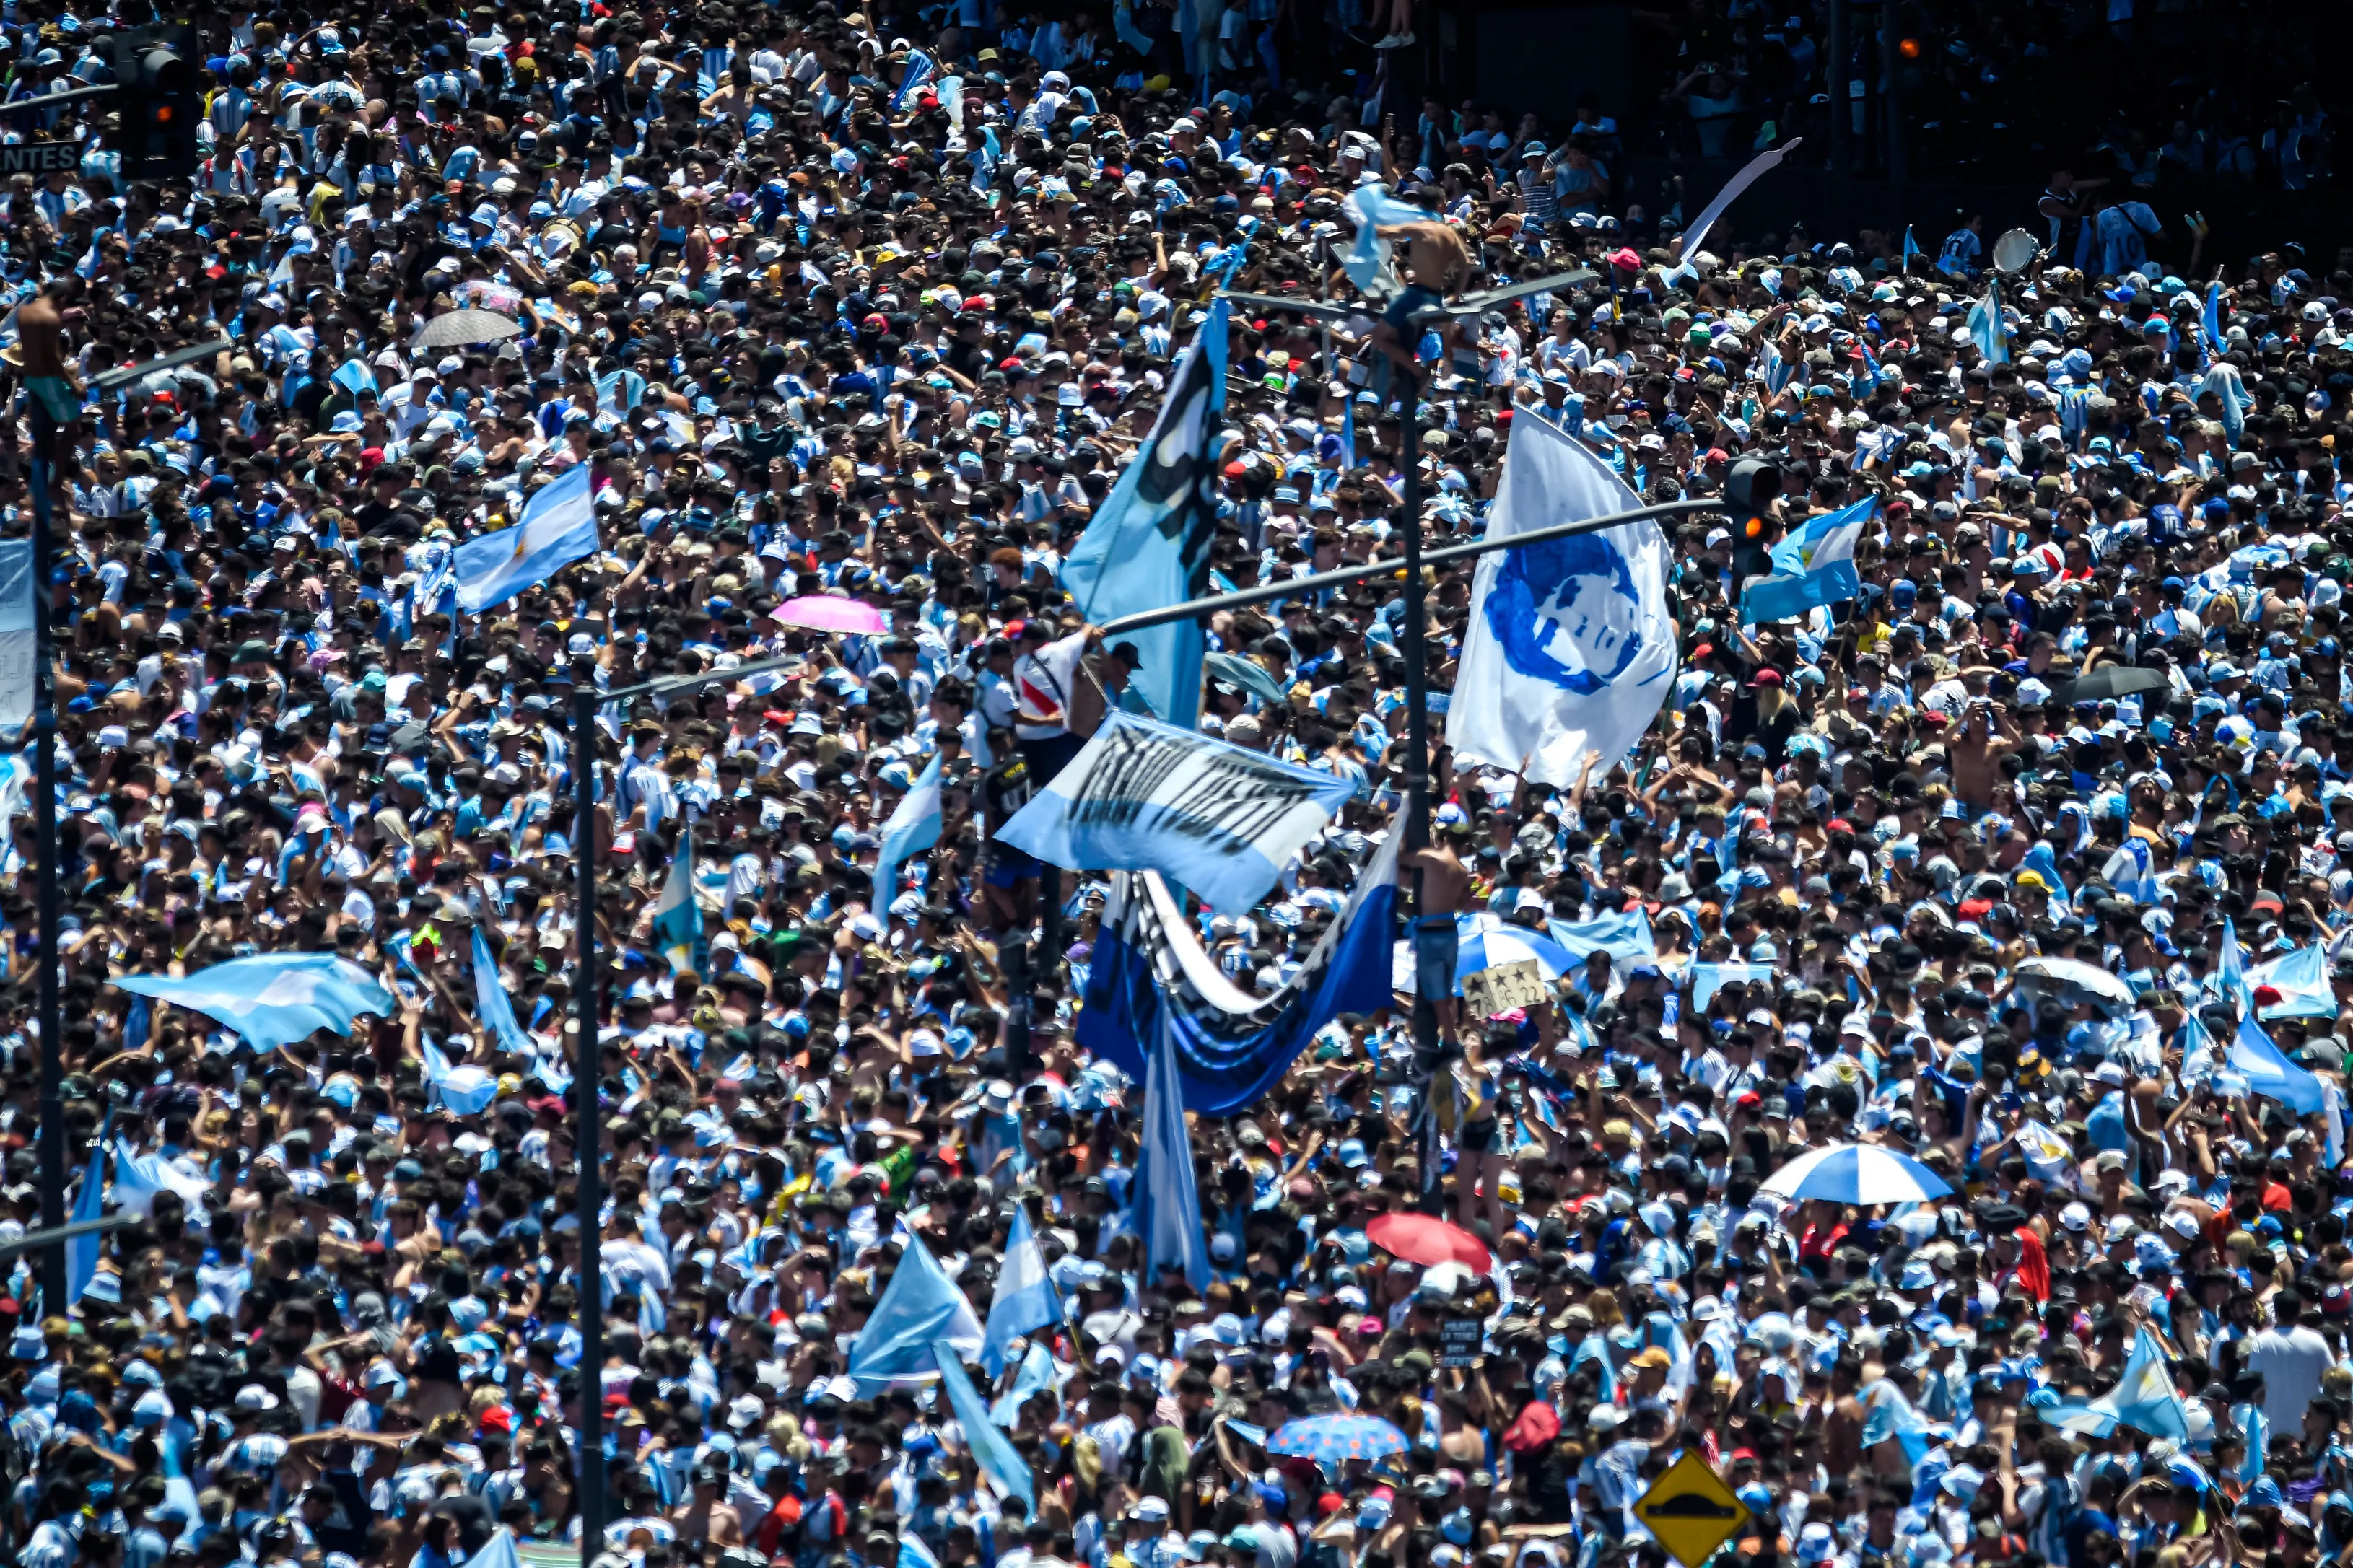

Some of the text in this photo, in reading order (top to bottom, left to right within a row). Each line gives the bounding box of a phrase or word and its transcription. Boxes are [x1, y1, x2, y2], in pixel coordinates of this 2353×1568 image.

[0, 146, 75, 171] NTES
[1467, 986, 1542, 1015] 78 86 22
